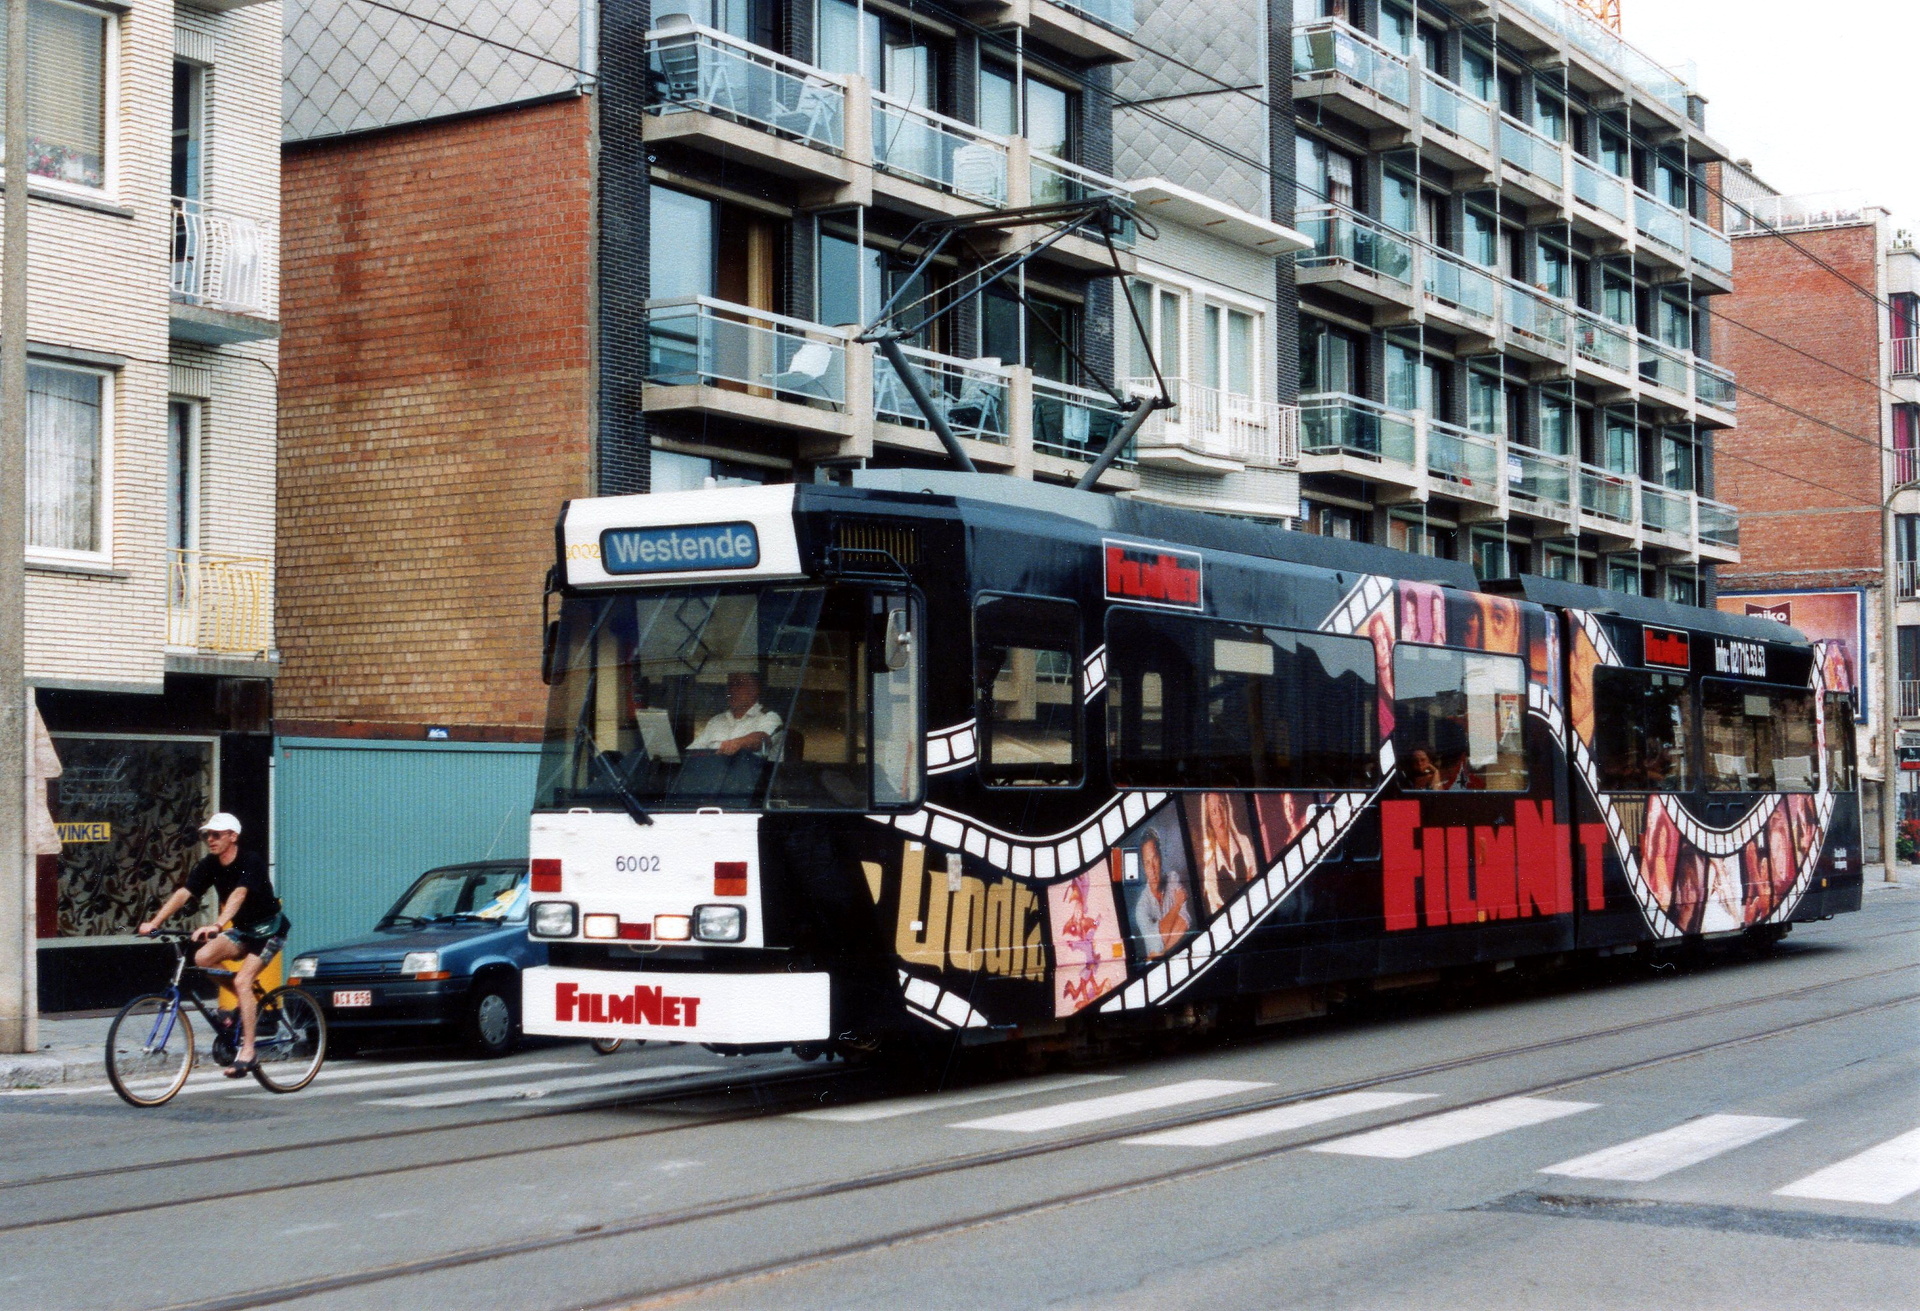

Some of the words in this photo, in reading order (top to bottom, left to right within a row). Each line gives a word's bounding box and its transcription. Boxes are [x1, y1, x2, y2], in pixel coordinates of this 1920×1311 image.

[612, 528, 751, 564] Westende
[57, 824, 109, 841] WINKEL
[616, 855, 660, 872] 6002
